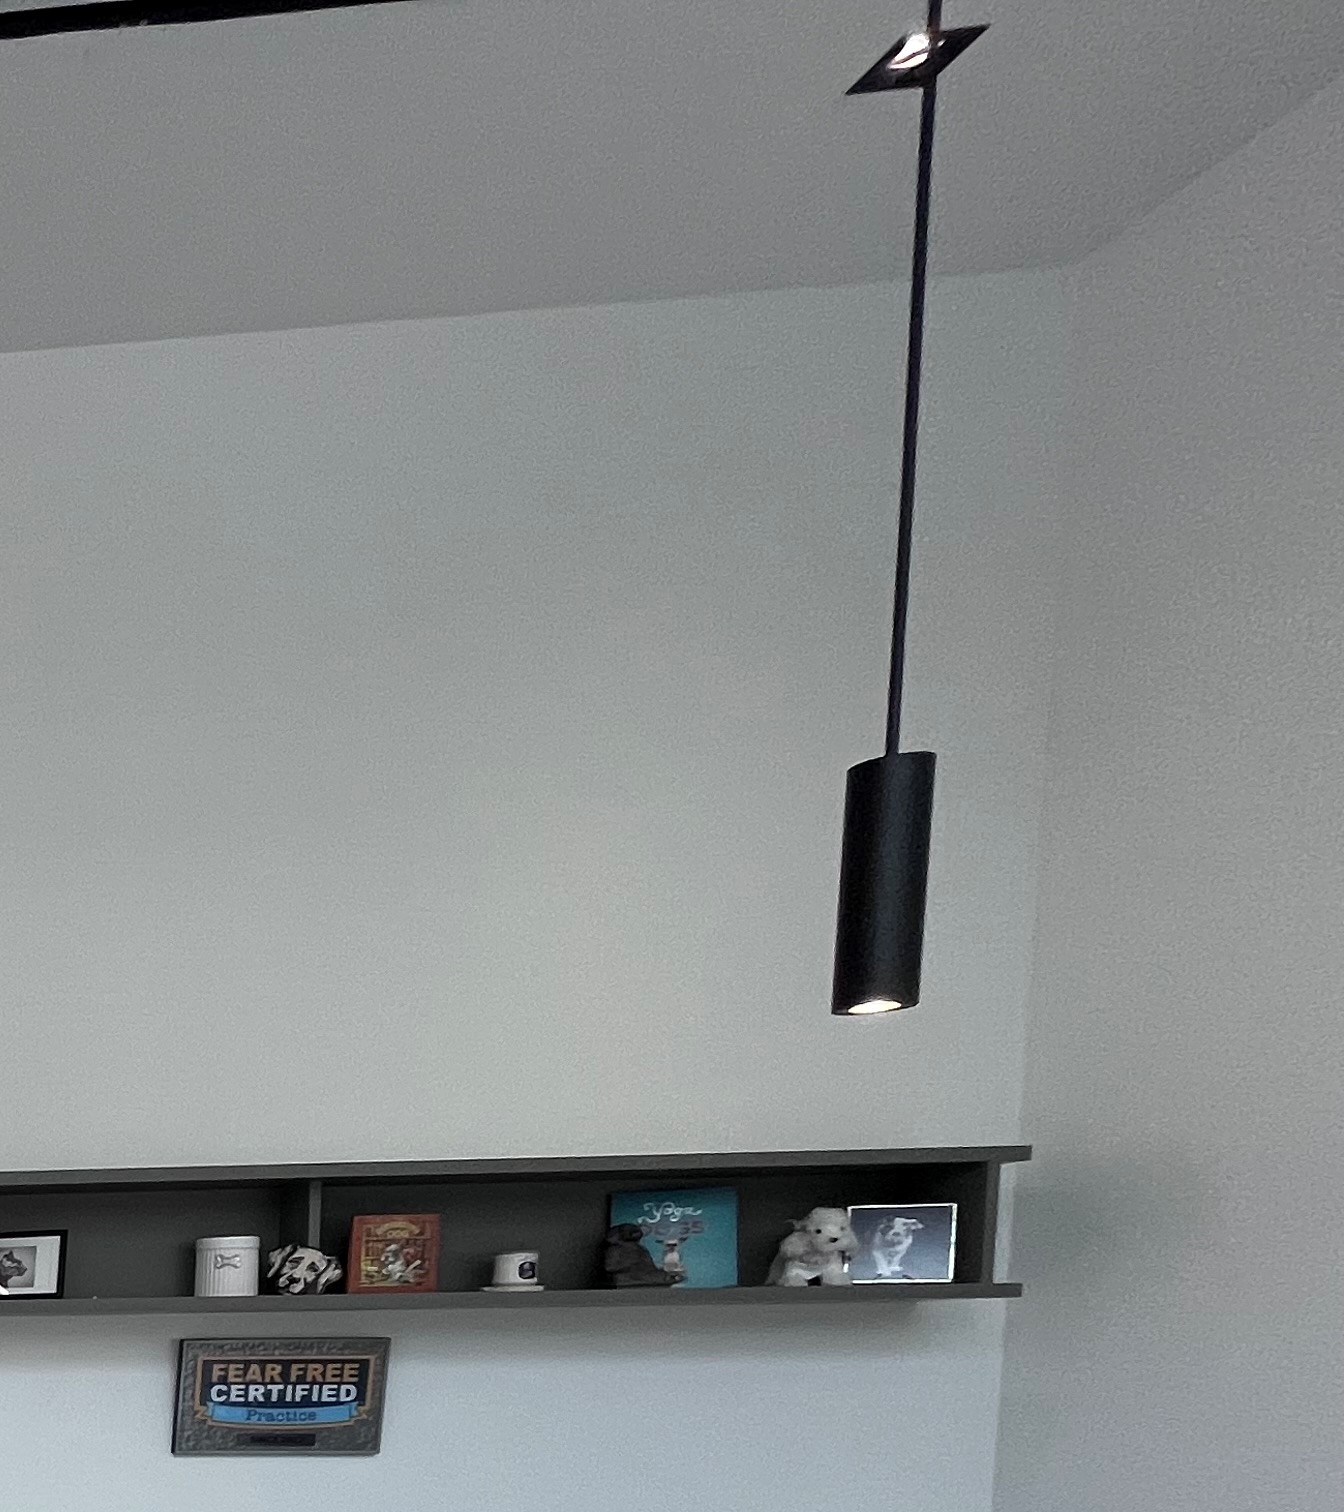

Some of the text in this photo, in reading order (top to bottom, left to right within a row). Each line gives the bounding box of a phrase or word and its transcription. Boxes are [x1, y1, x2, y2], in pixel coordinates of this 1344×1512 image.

[638, 1202, 703, 1223] Yoga
[212, 1362, 361, 1383] FEAR FREE
[210, 1384, 358, 1403] CERTIFIED
[245, 1408, 317, 1422] Practice
